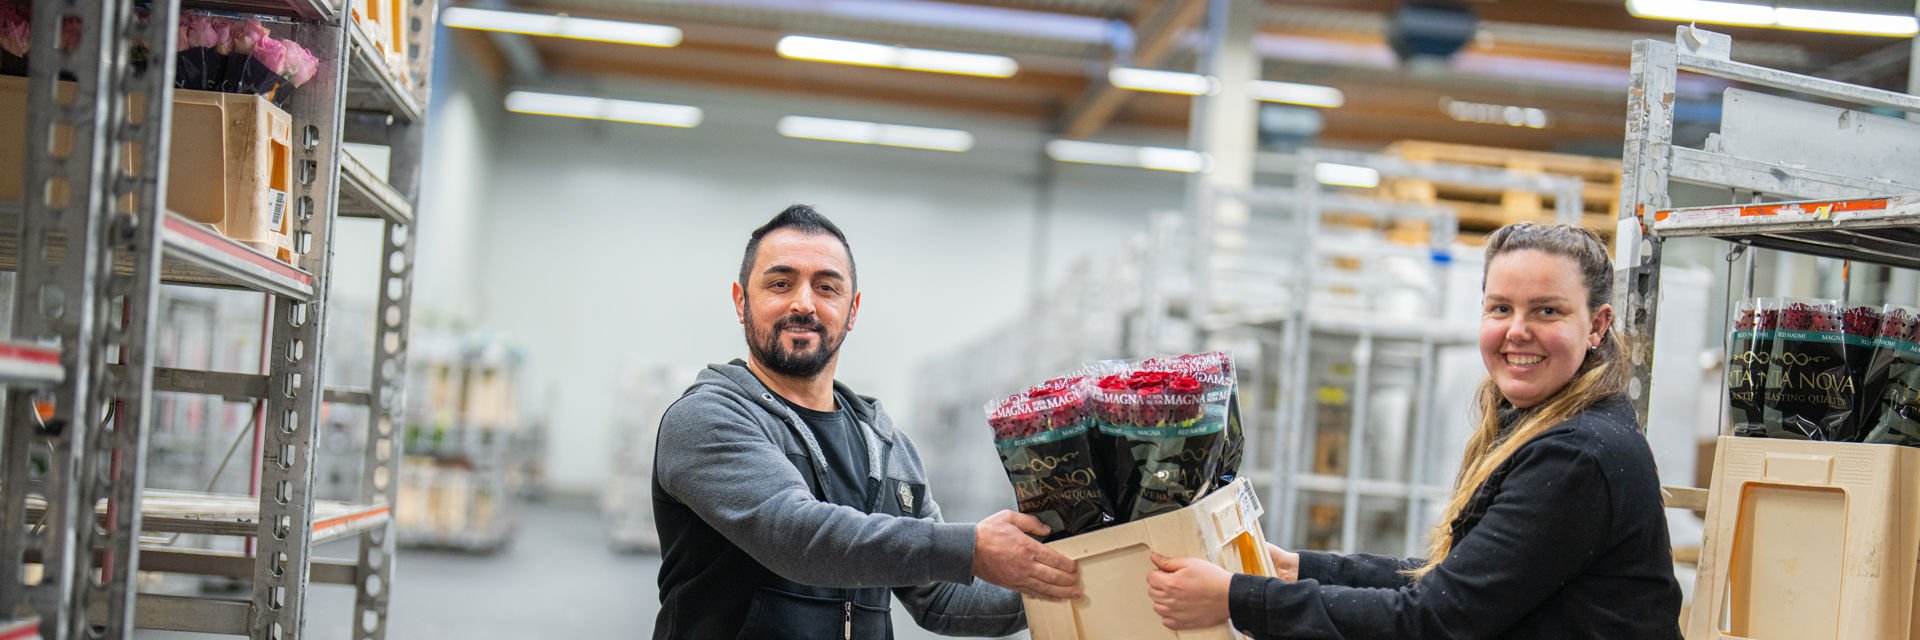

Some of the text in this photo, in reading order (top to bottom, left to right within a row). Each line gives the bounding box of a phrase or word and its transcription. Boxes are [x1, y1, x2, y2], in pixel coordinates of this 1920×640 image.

[1800, 371, 1856, 395] NOVA
[1046, 388, 1082, 411] MAGN
[1104, 392, 1145, 406] MAGNA
[1164, 393, 1206, 406] MAGNA
[996, 403, 1033, 418] MAGNA
[1015, 478, 1055, 499] RTA
